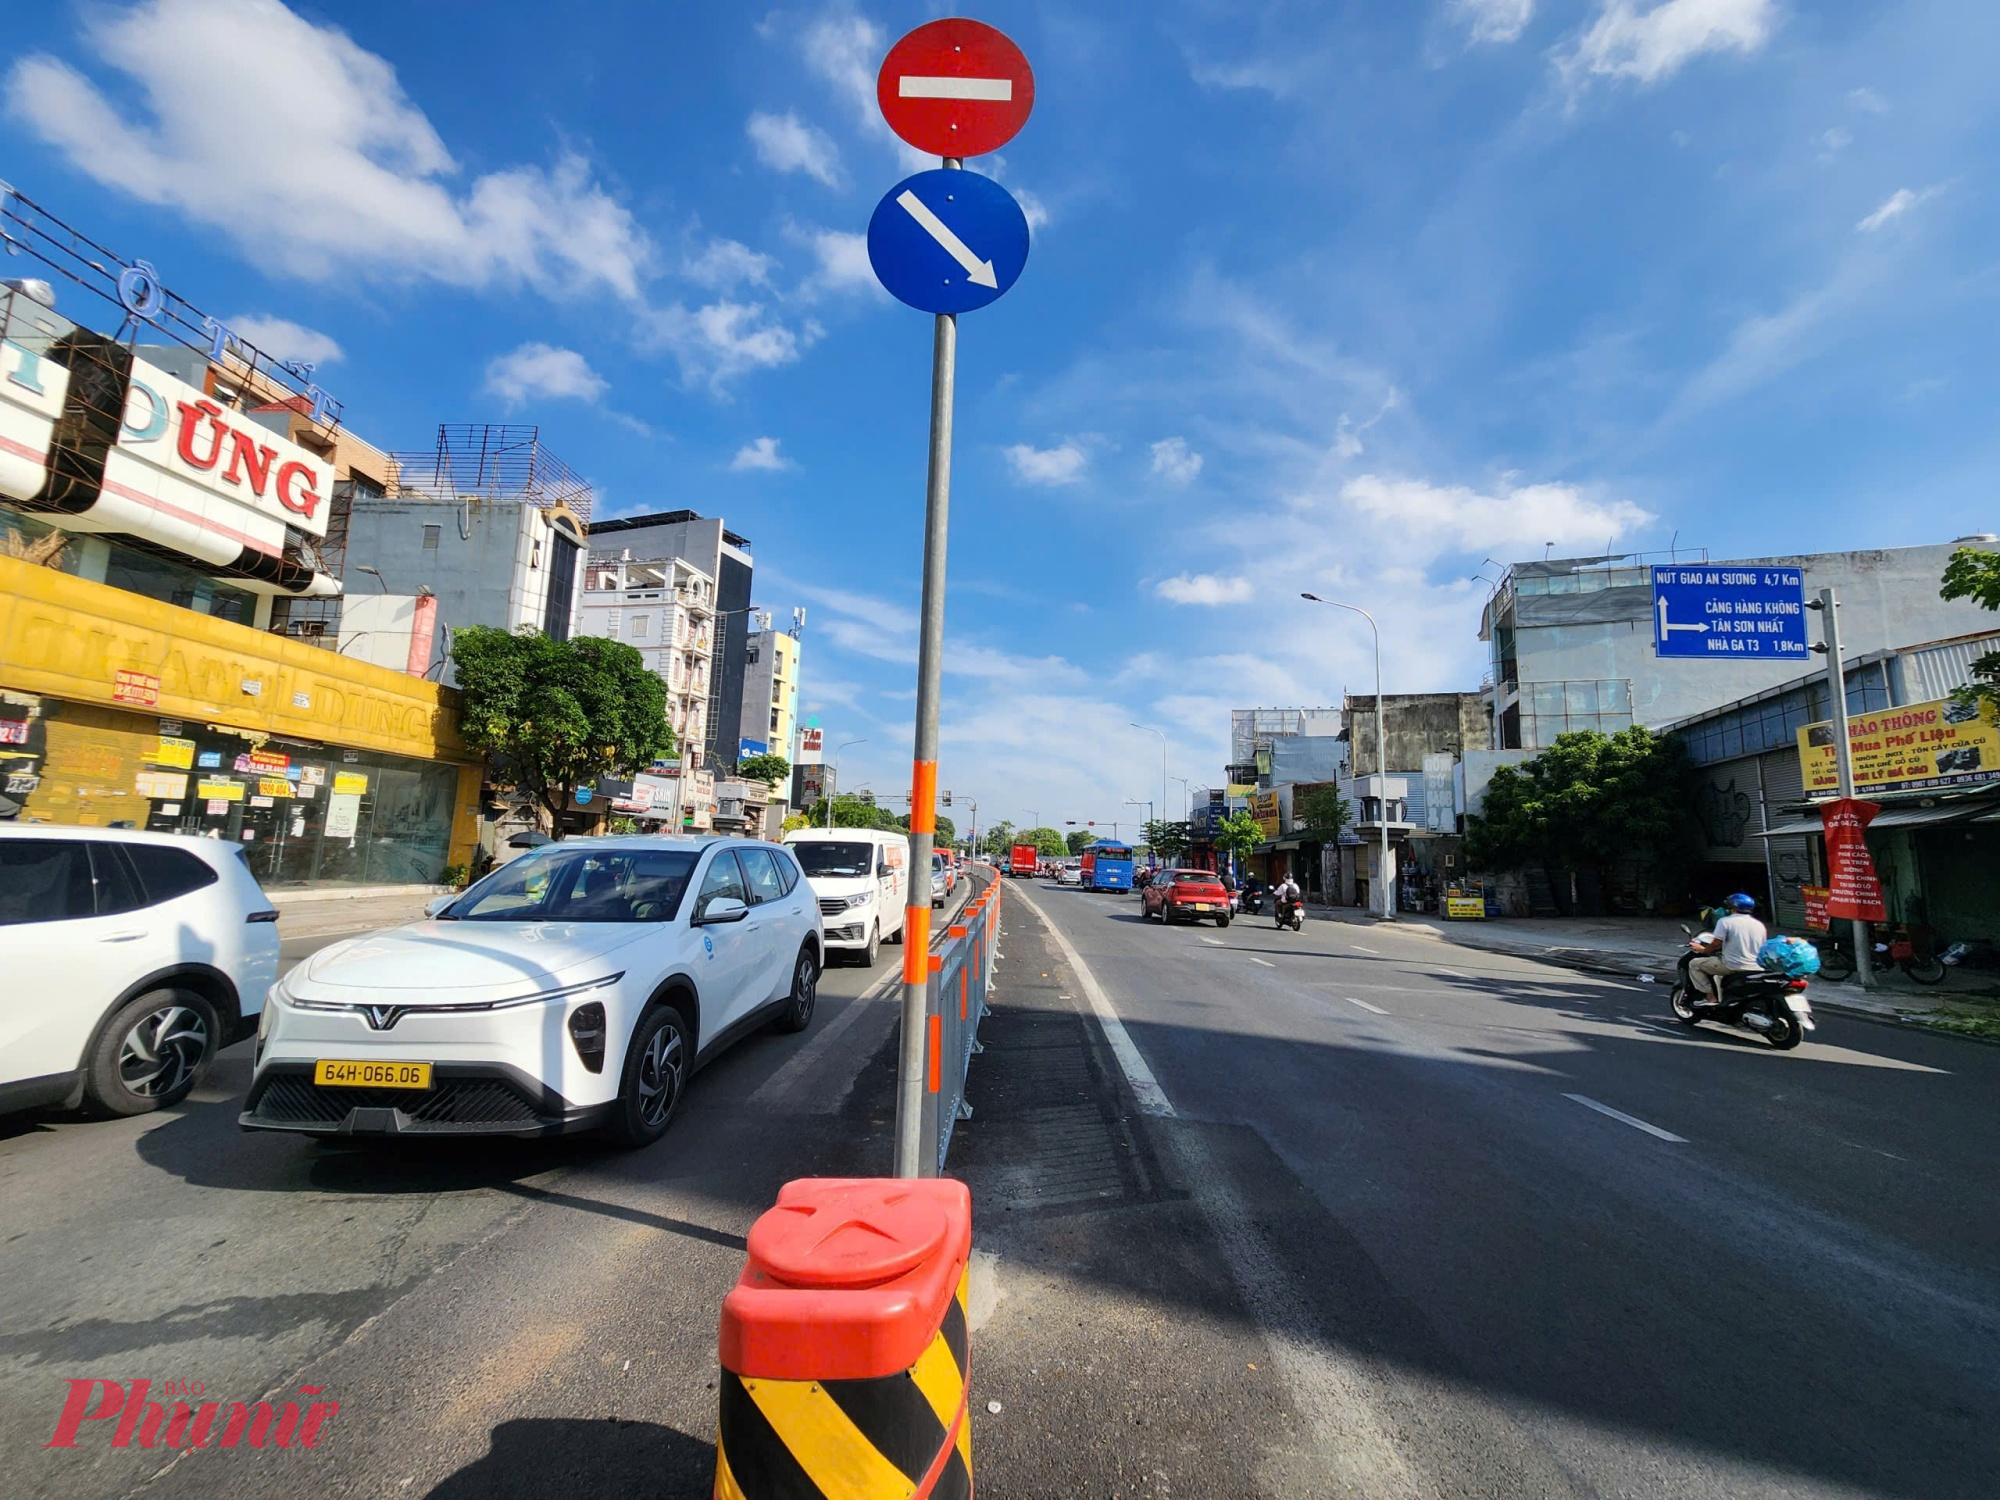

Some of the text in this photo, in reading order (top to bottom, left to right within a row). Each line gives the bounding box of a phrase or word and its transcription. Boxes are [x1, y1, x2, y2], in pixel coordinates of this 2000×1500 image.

[1657, 568, 1676, 584] NÚT
[1680, 573, 1702, 585] GIAO
[1705, 573, 1719, 585] AN
[1721, 572, 1757, 586] SƯƠNG
[1782, 573, 1799, 586] Km
[1705, 597, 1800, 615] CẢNG HÀNG KHÔNG
[1711, 616, 1784, 633] TÂN SƠN NHẤT
[1707, 636, 1729, 651] NHÀ
[1731, 640, 1745, 651] GA
[1747, 640, 1760, 651] T3
[1881, 709, 1937, 732] THÔNG
[1851, 740, 1881, 754] Mua
[1885, 731, 1917, 748] Phế
[1919, 728, 1956, 743] Liệu
[1911, 745, 1929, 754] TÔN
[325, 1064, 421, 1084] 64H-066.06
